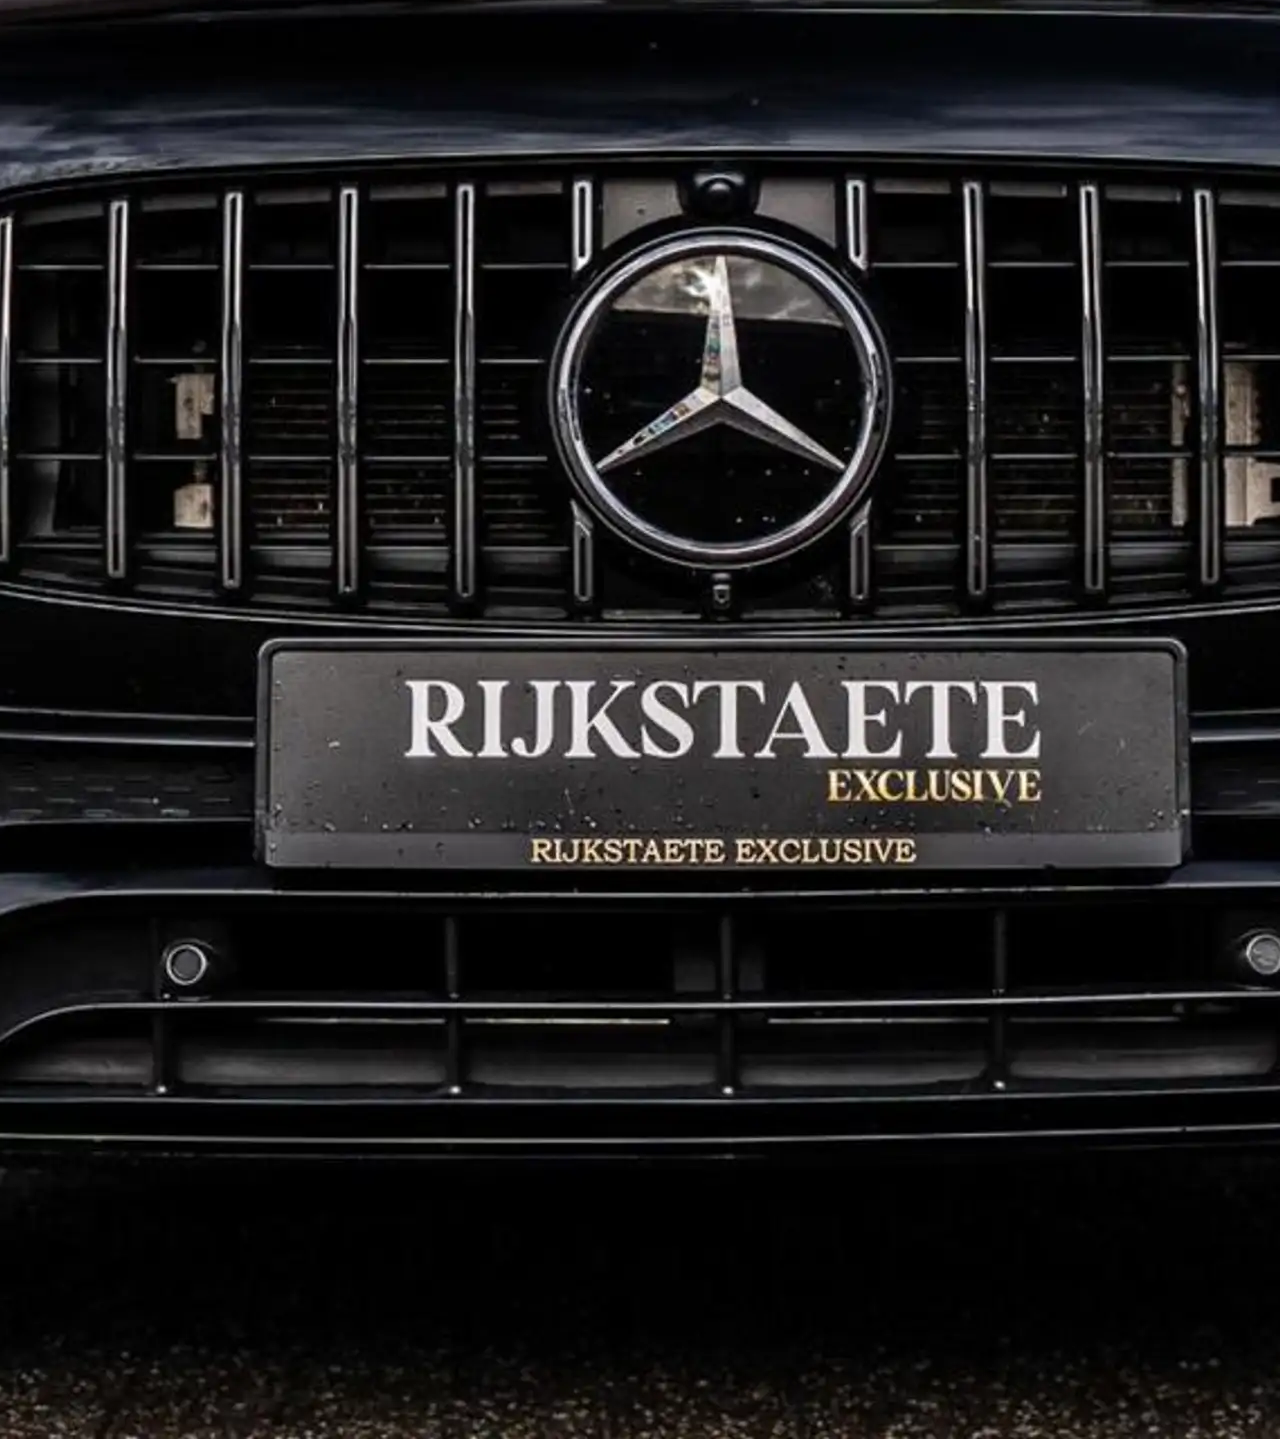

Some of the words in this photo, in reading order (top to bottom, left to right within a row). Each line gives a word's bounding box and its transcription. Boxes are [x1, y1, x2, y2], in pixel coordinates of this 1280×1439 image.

[404, 679, 1042, 759] RIJKSTAETE
[826, 768, 1043, 805] EXCLUSIVE
[530, 837, 726, 865] RIJKSTAETE
[734, 837, 918, 865] EXCLUSIVE
